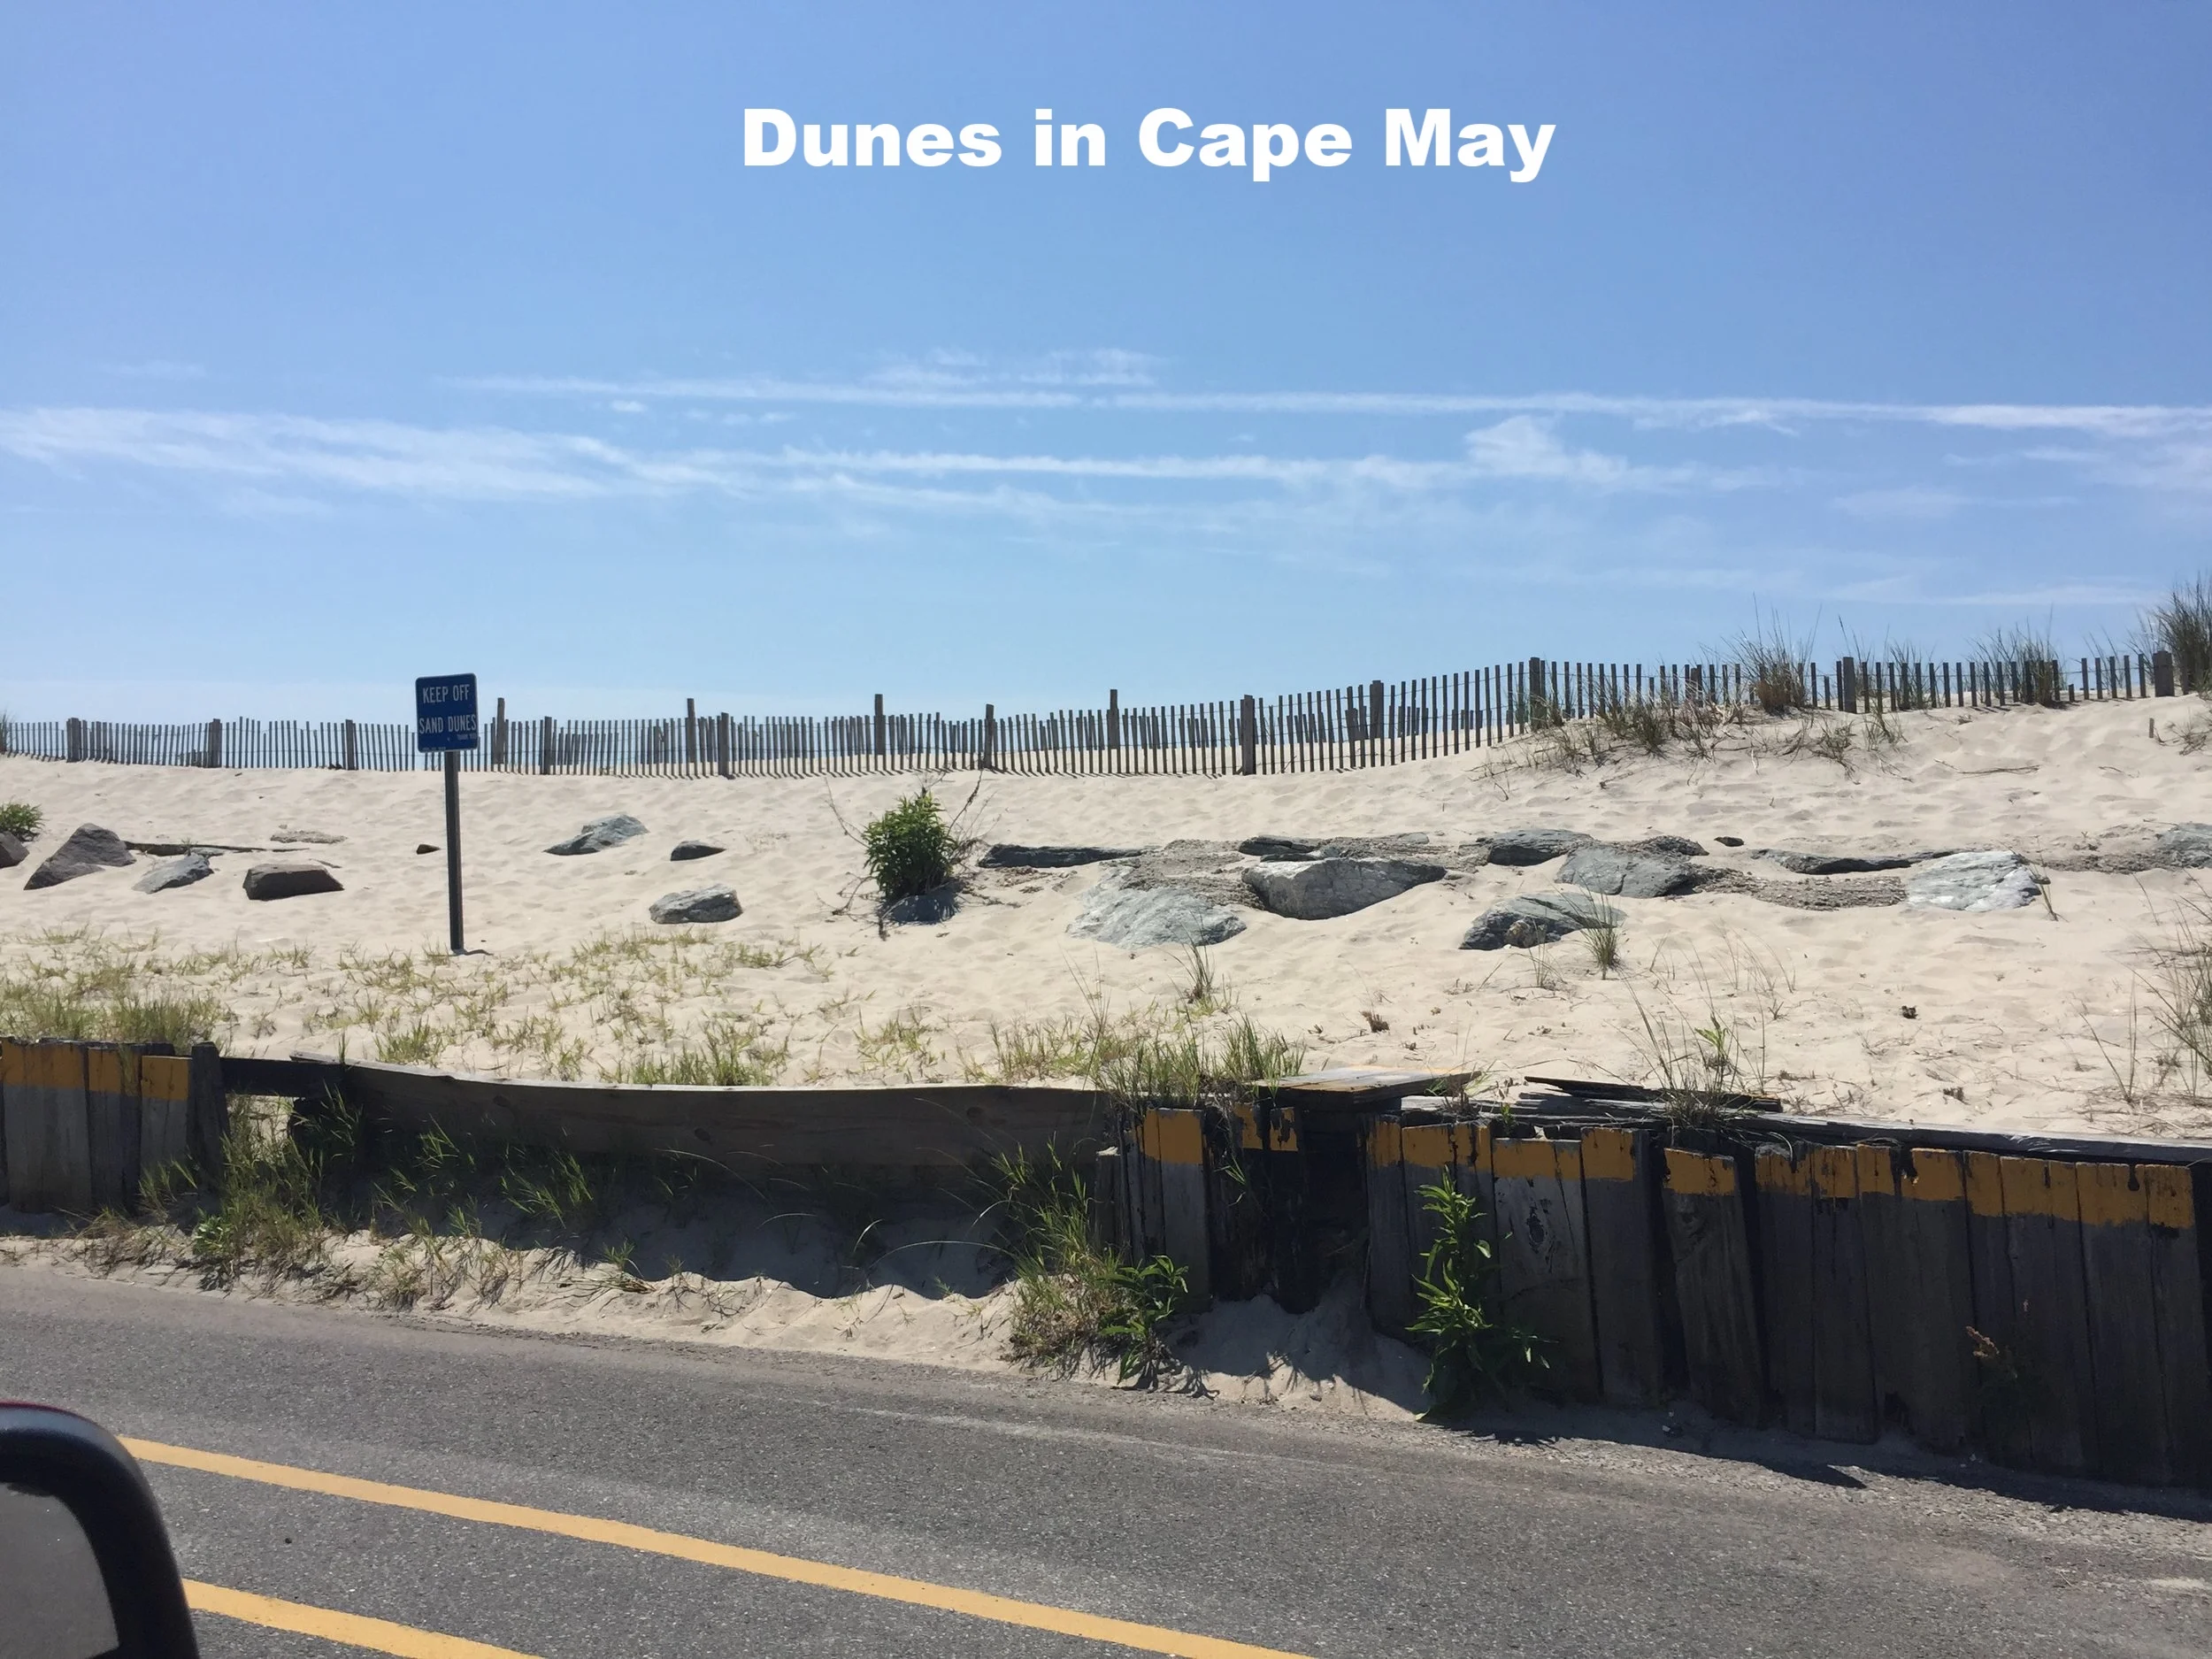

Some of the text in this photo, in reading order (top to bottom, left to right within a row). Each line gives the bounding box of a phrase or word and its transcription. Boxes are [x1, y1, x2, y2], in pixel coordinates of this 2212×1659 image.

[422, 683, 471, 704] KEEP OFF
[419, 714, 477, 734] SAND DUNES
